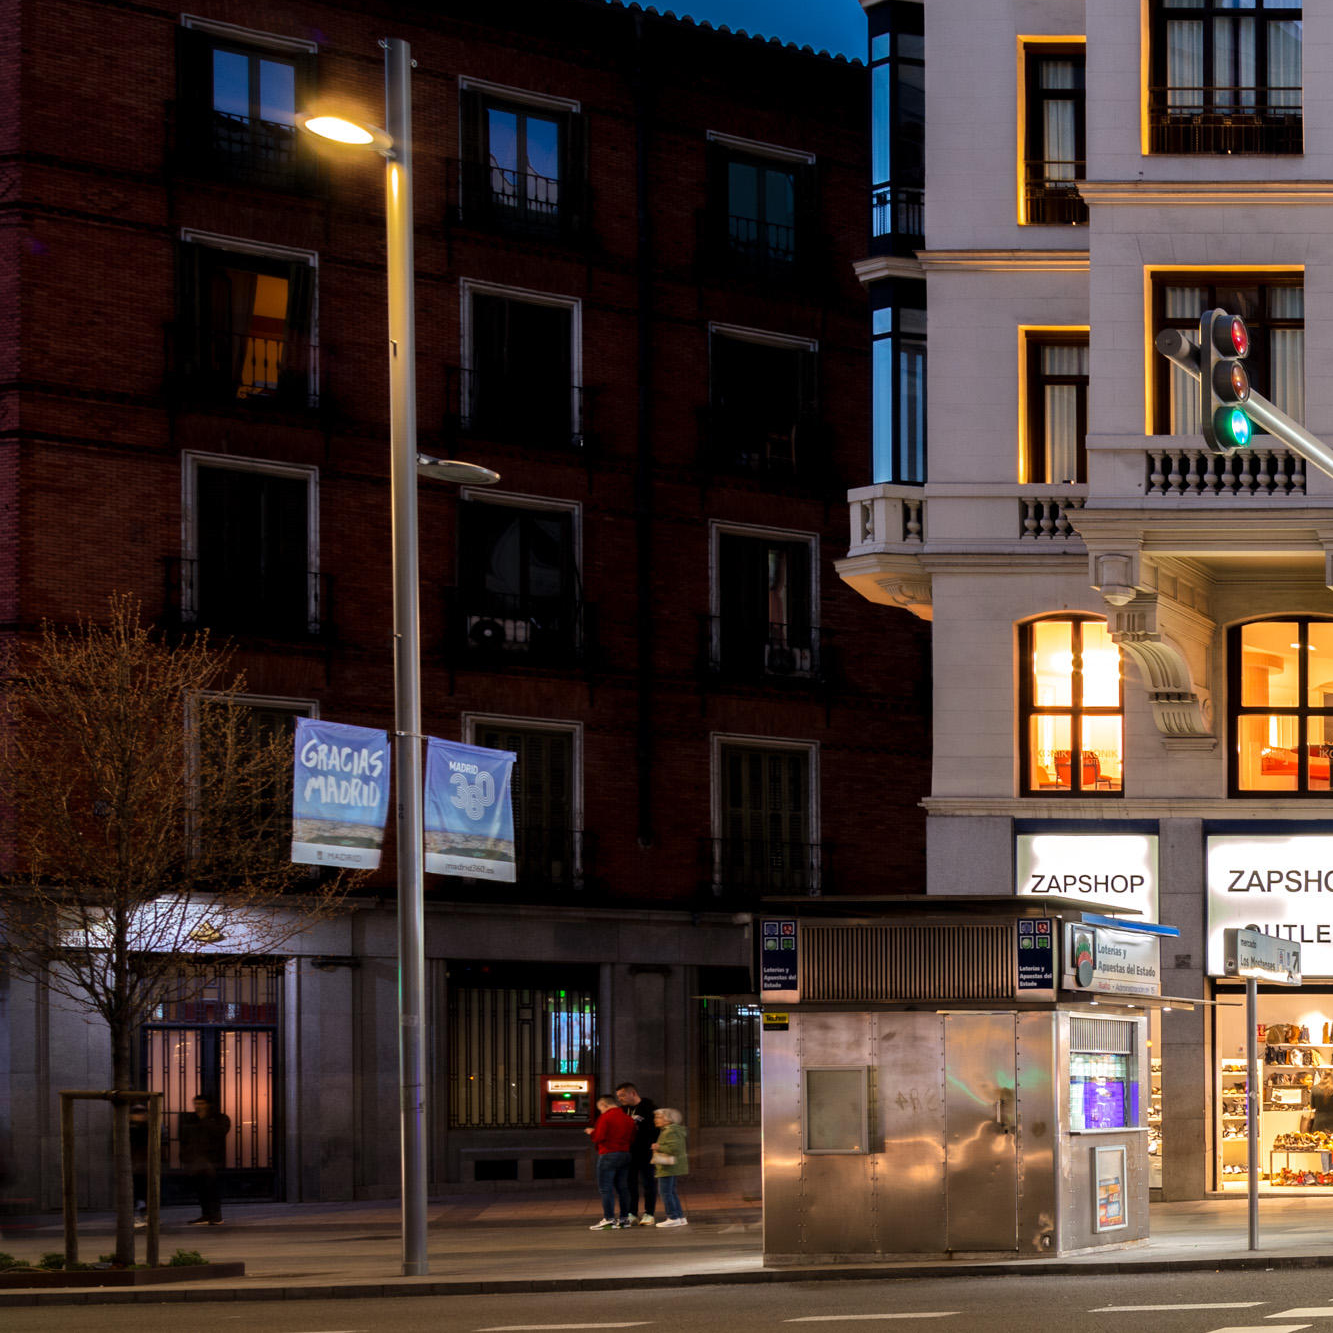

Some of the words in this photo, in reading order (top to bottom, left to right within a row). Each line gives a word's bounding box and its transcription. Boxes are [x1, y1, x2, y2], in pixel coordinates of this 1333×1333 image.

[301, 739, 384, 778] GRACIAS
[450, 761, 479, 775] MADRID
[305, 776, 380, 807] MADRID
[450, 770, 495, 821] 360
[327, 852, 362, 863] MADRID
[446, 863, 495, 875] madrid360.es
[1031, 874, 1145, 893] ZAPSHOP
[1123, 949, 1128, 960] y
[1240, 953, 1249, 967] Los
[1098, 960, 1126, 974] Apuestas
[1127, 963, 1136, 975] del
[1136, 965, 1156, 977] Estado
